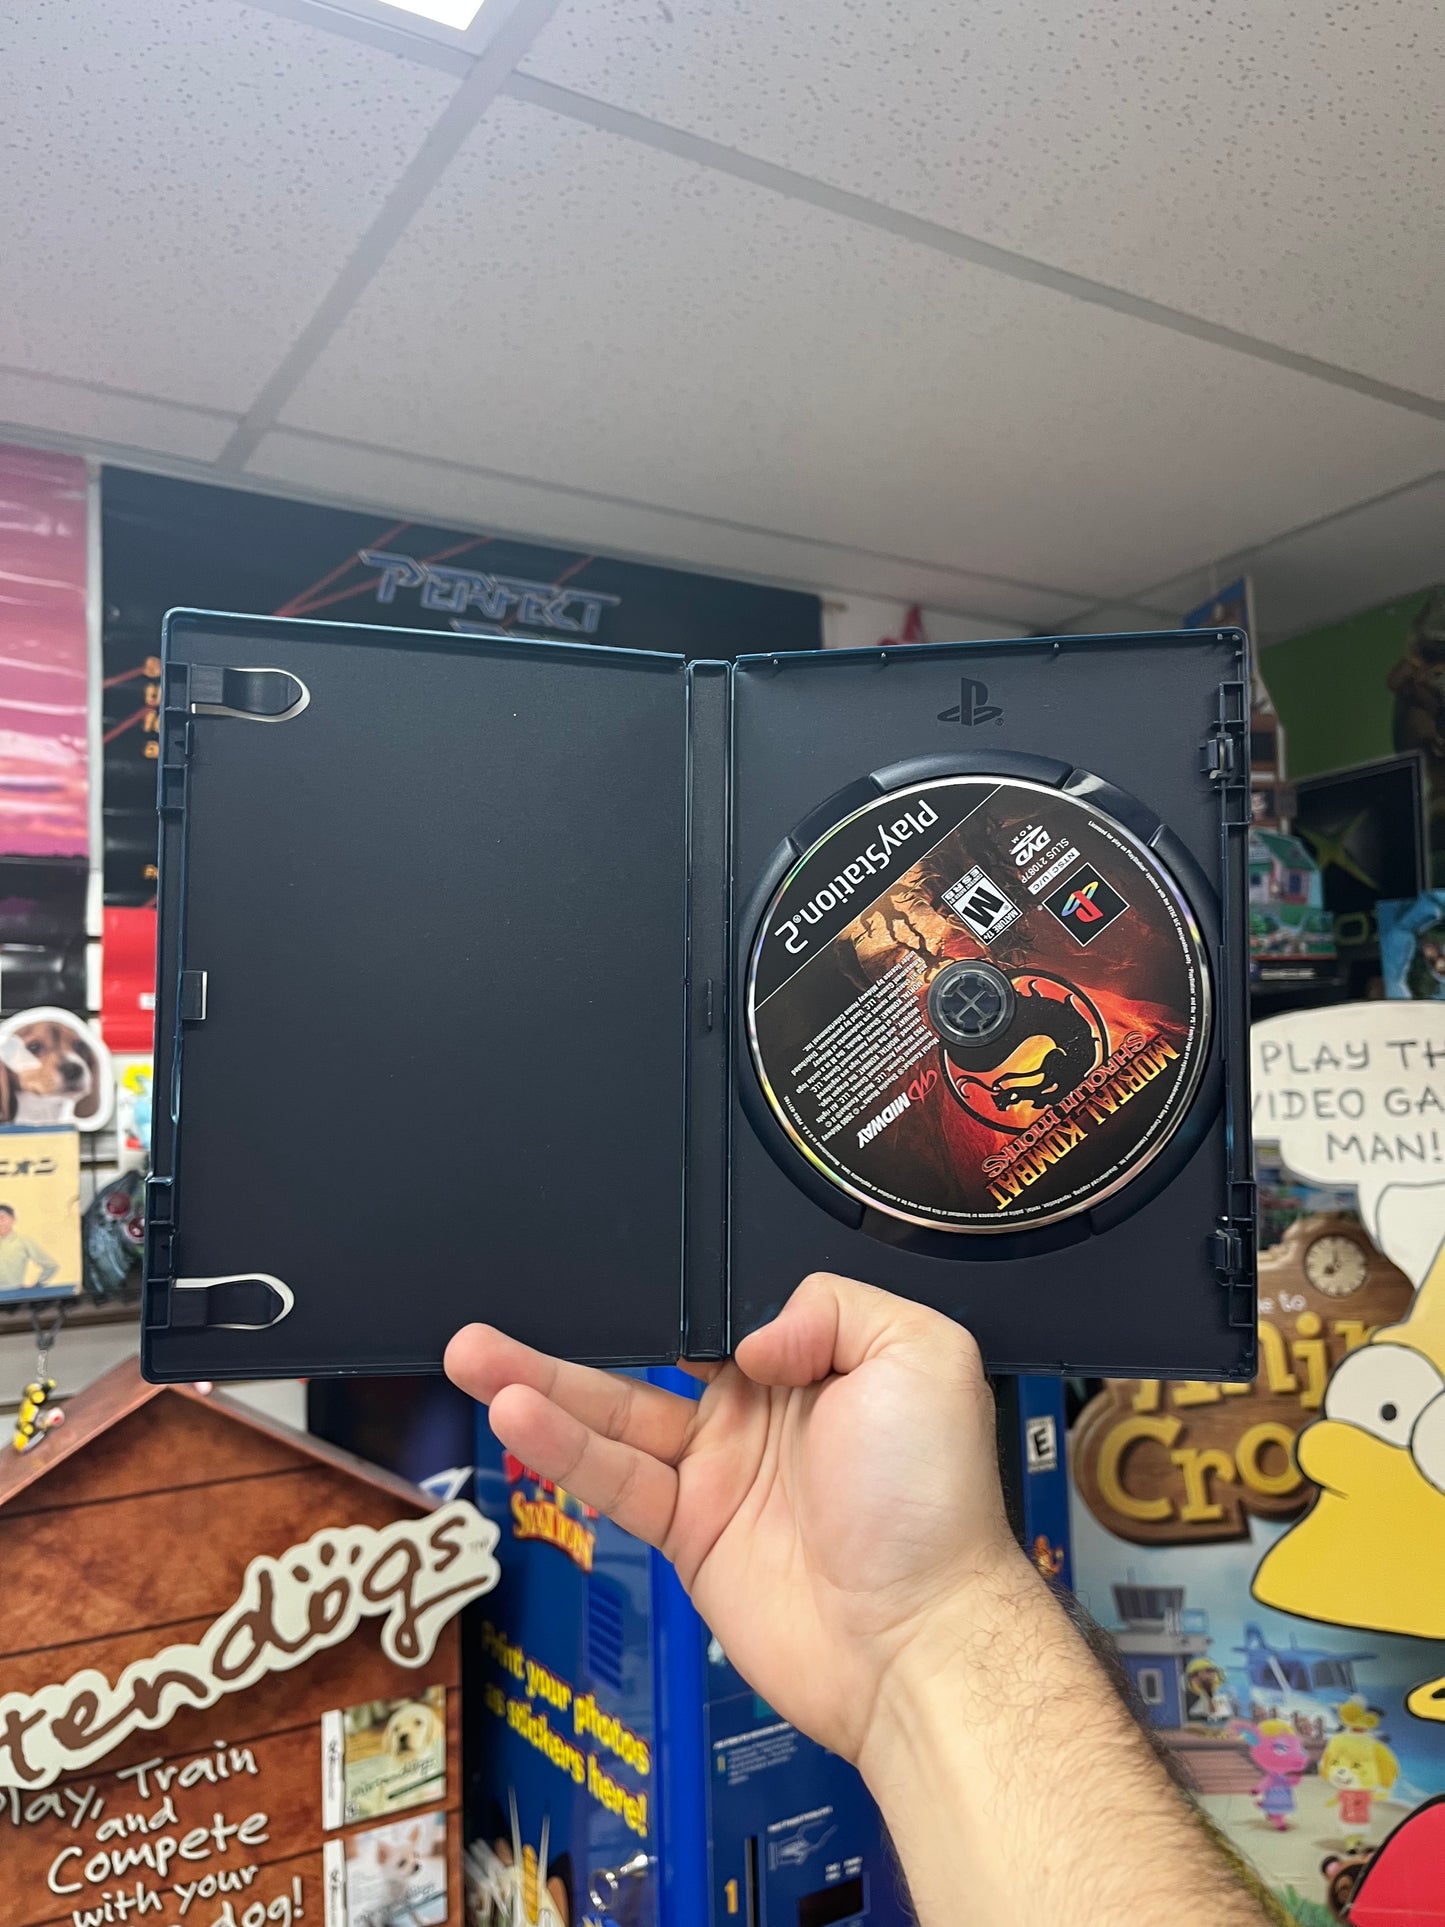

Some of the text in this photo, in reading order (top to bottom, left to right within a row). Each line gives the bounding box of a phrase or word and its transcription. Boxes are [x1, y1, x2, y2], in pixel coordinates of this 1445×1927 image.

[1010, 823, 1033, 844] ROM
[1016, 830, 1051, 866] DVD
[1017, 836, 1070, 884] SLUS 21087P
[1031, 851, 1075, 891] NTSC U/C
[943, 867, 980, 900] ESRB
[961, 885, 1004, 929] M
[981, 908, 1019, 942] MATURE 17+
[1260, 1040, 1370, 1075] PLAY
[858, 1091, 909, 1149] MIDWAY
[981, 1033, 1180, 1212] MORTAL KOMBAT
[1327, 1128, 1442, 1164] MAN!
[1033, 1427, 1050, 1457] E
[525, 1658, 573, 1713] your
[573, 1691, 650, 1776] photos
[506, 1697, 585, 1784] stickers
[116, 1740, 258, 1798] Train
[95, 1796, 179, 1842] and
[47, 1812, 270, 1894] Compete
[72, 1864, 259, 1927] with your
[724, 1878, 739, 1915] 1
